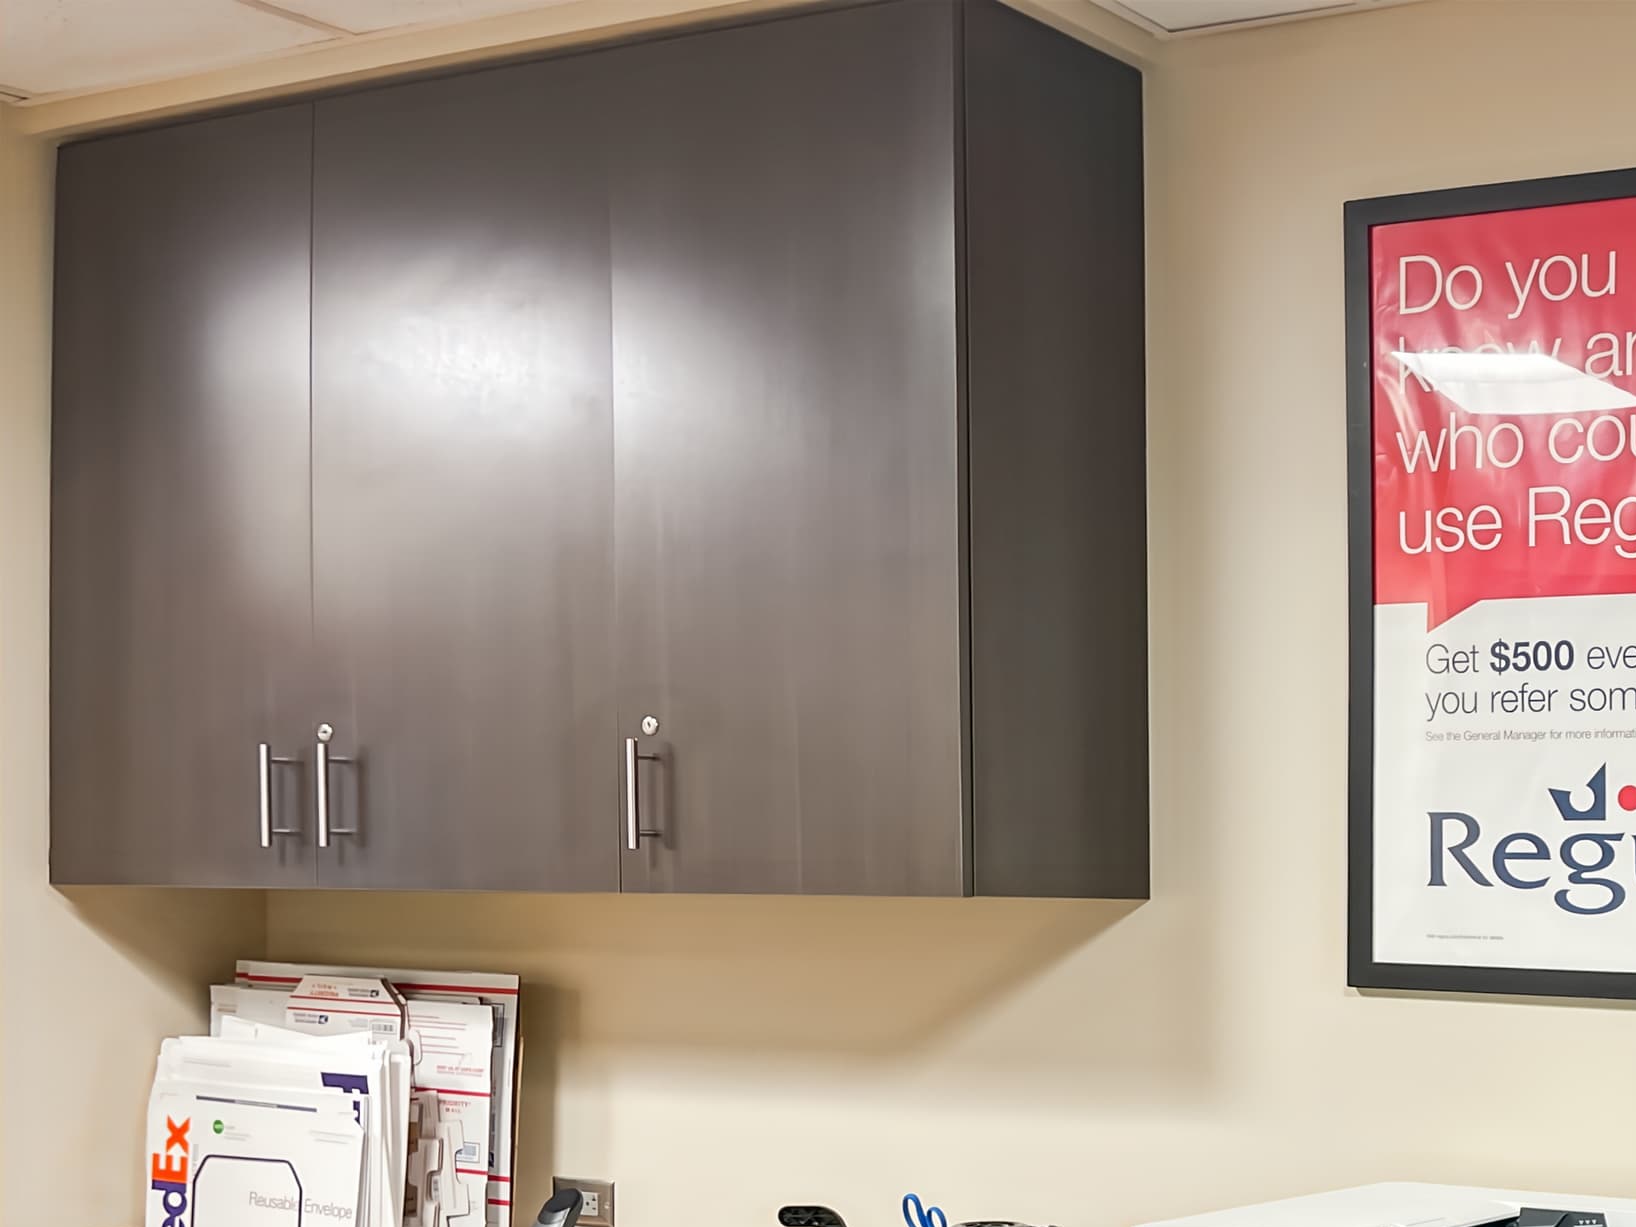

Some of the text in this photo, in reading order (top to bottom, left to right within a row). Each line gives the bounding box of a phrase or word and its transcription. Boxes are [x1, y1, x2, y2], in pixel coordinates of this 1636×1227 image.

[1399, 251, 1617, 319] Do you
[1396, 412, 1524, 474] who
[1399, 503, 1502, 555] use
[1426, 642, 1480, 675] Get
[1489, 639, 1575, 675] $500
[1425, 690, 1478, 722] you
[1489, 683, 1559, 714] refer
[1425, 731, 1444, 742] See
[1446, 731, 1461, 741] the
[1463, 730, 1501, 741] General
[1503, 729, 1547, 743] Manager
[1550, 729, 1563, 740] for
[1565, 730, 1592, 740] more
[304, 1198, 353, 1221] Envelope
